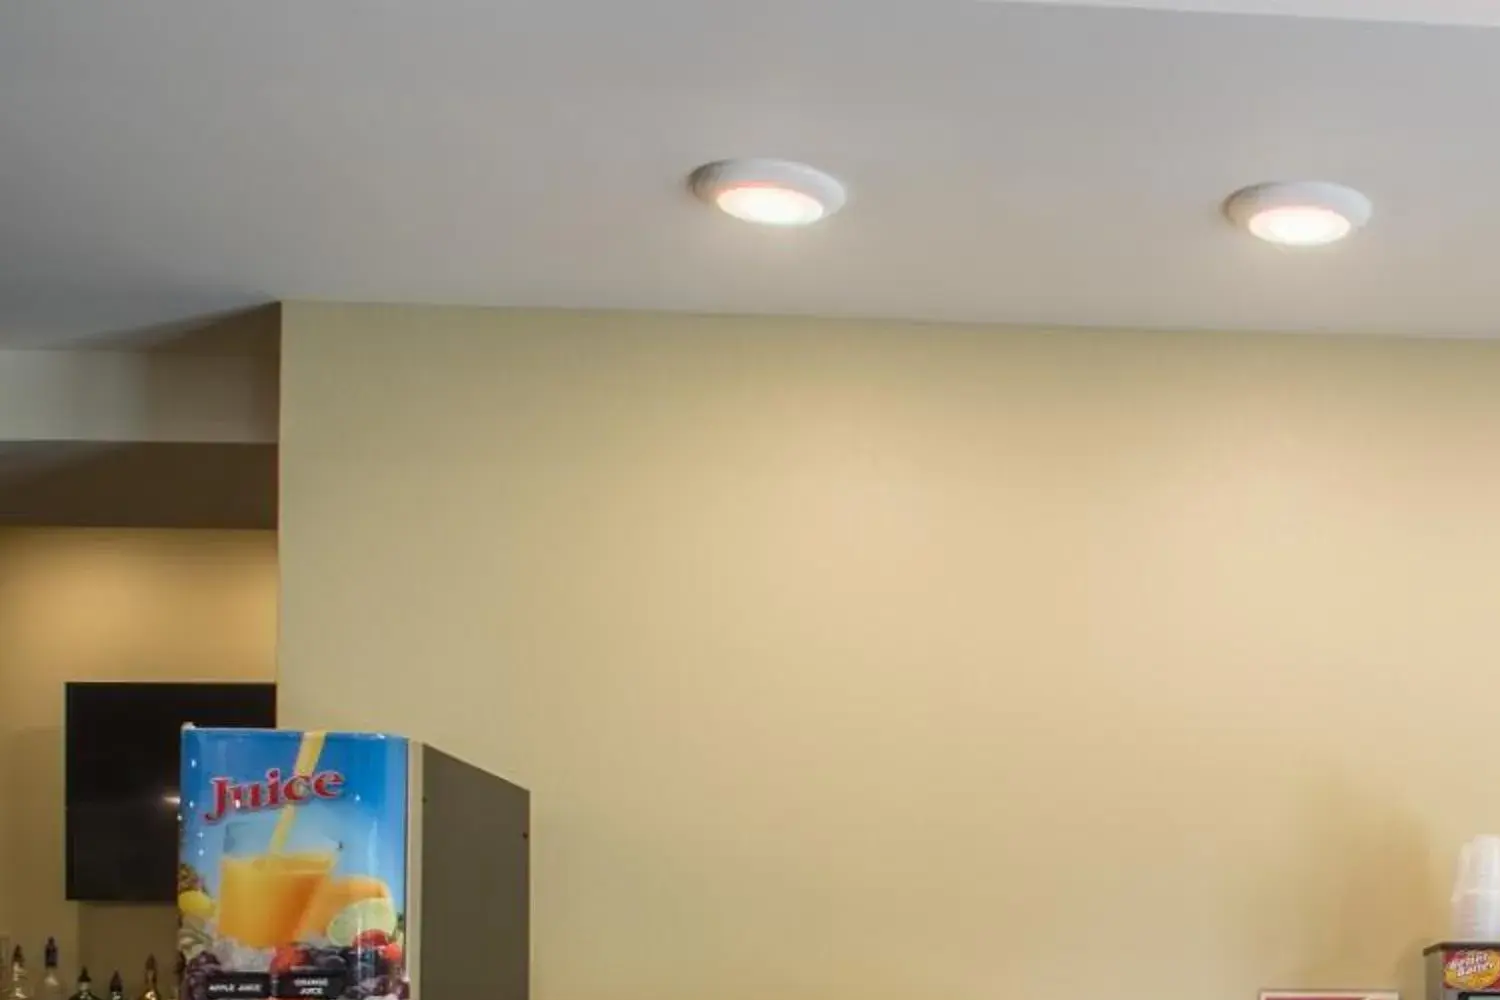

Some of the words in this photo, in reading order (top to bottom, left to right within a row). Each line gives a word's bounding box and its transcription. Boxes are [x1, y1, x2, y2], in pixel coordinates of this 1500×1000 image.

[204, 768, 345, 825] Juice
[208, 983, 236, 993] APPLE
[238, 983, 262, 993] JUICE
[299, 987, 324, 996] JUICE
